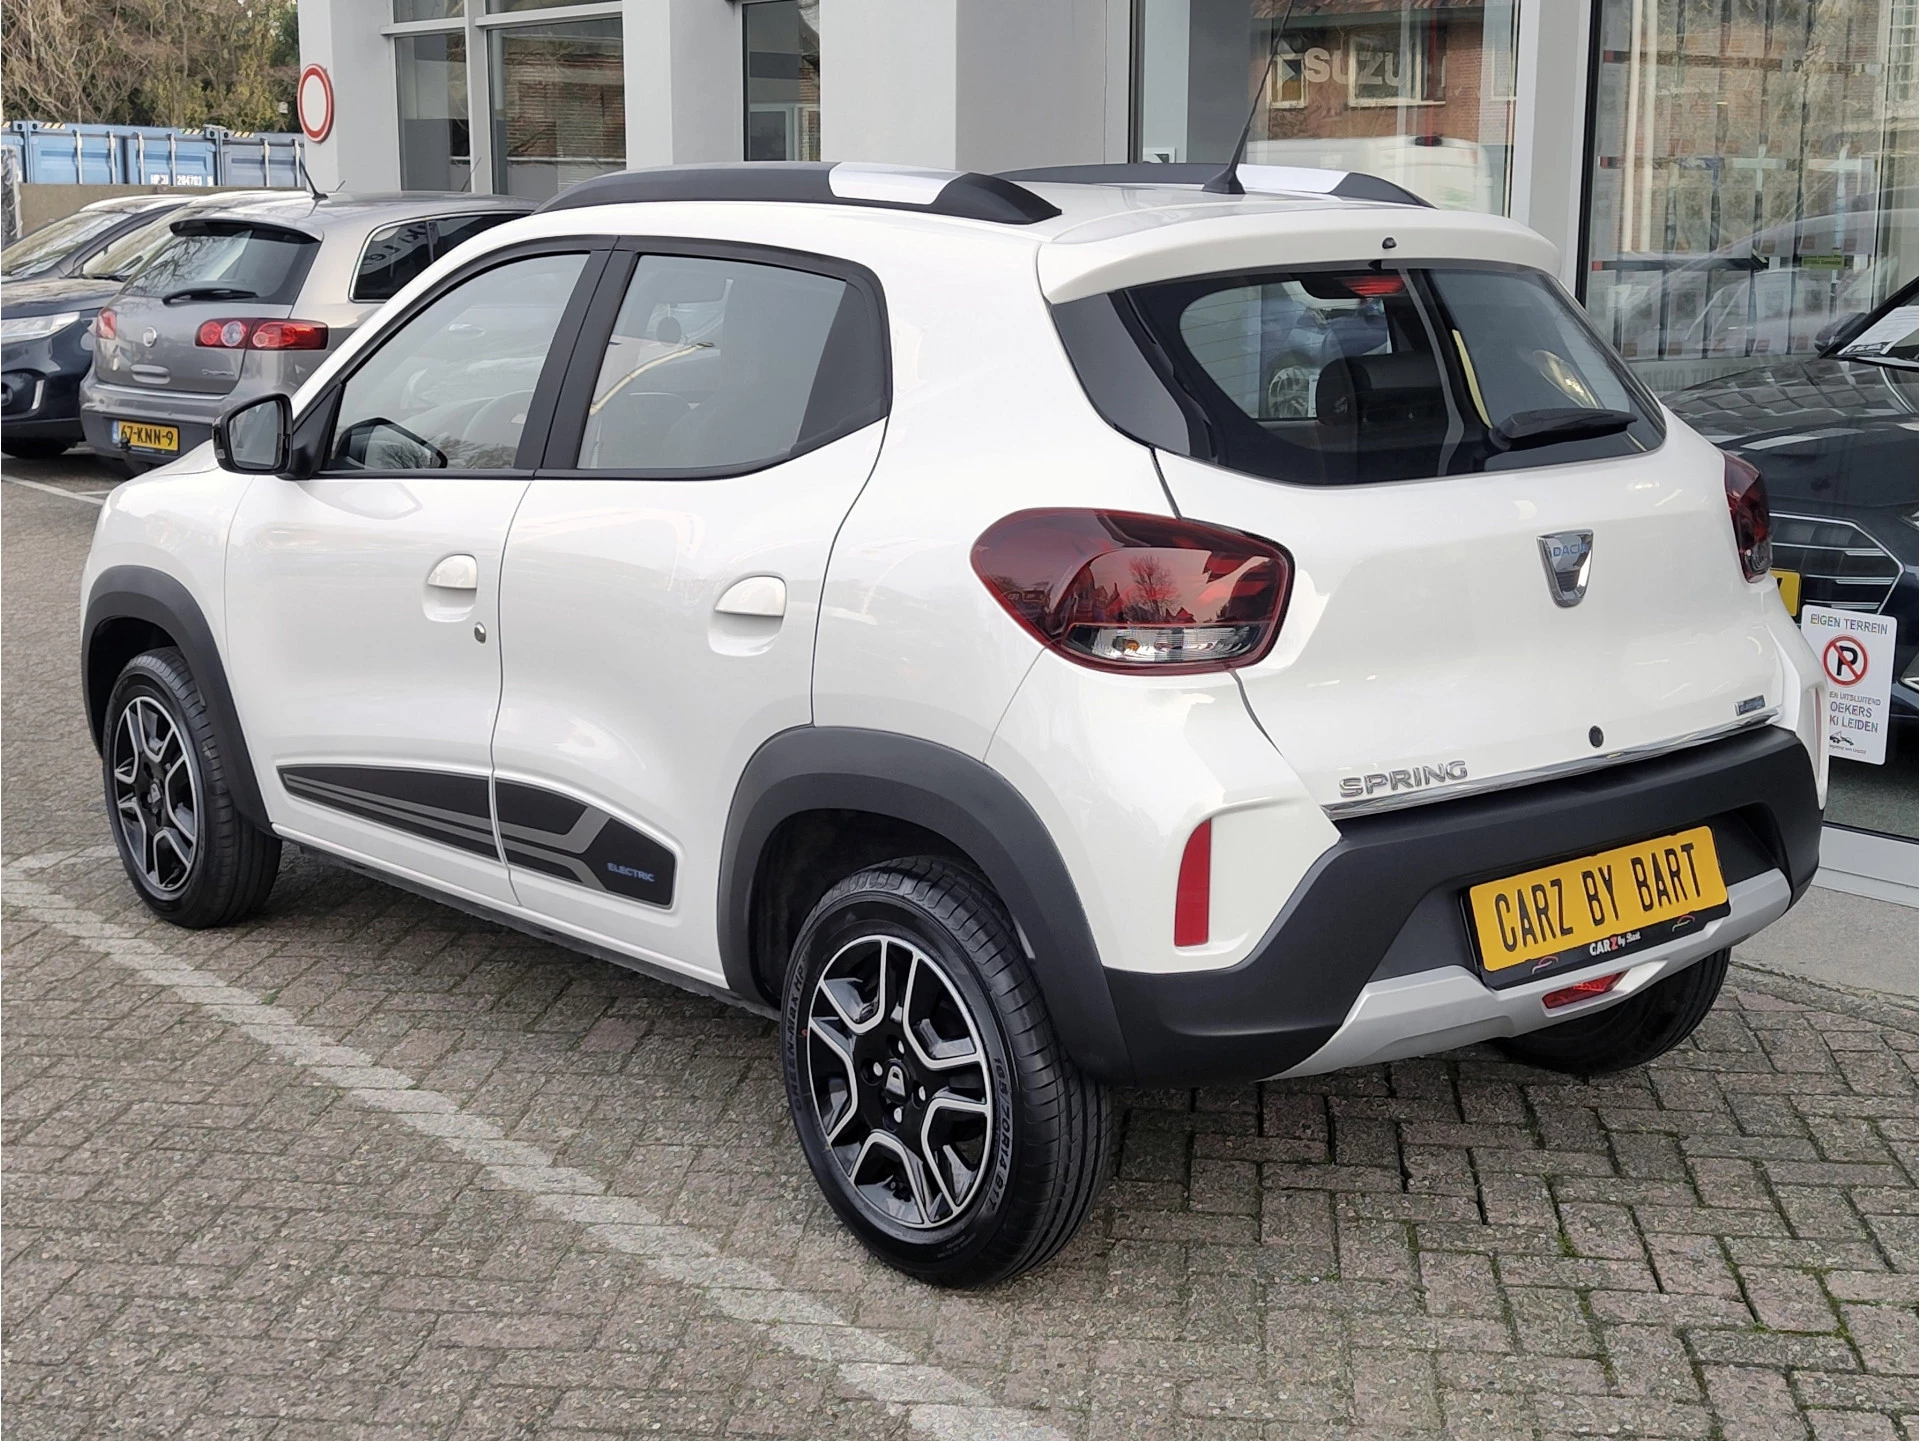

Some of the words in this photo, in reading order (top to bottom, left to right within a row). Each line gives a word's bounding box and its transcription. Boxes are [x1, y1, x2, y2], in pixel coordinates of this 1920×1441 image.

[120, 424, 174, 446] 67-KNN-9
[1553, 543, 1588, 557] DACIA
[1810, 613, 1841, 629] EIGEN
[1844, 618, 1888, 635] TERREIN
[1840, 692, 1881, 706] UITSLUITEND
[1830, 701, 1872, 718] OEKERS
[1842, 717, 1879, 733] LEIDEN
[1339, 760, 1468, 798] SPRING
[607, 862, 656, 882] ELECTRIC
[1494, 878, 1574, 952] CARZ
[1580, 864, 1619, 927] BY
[1630, 842, 1701, 912] BART
